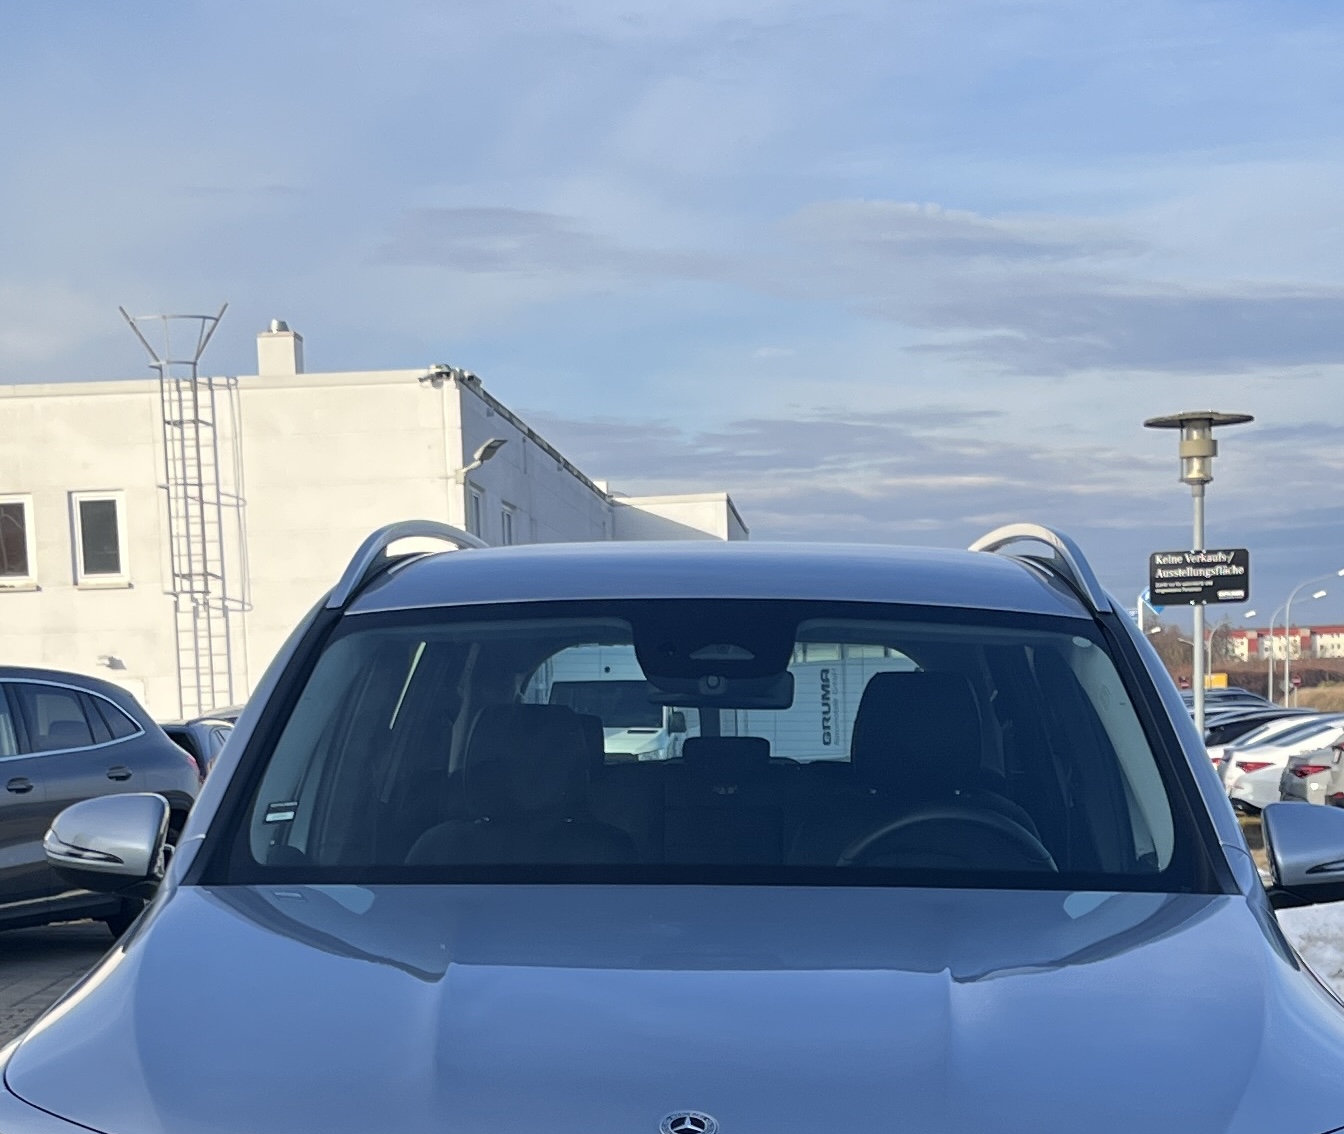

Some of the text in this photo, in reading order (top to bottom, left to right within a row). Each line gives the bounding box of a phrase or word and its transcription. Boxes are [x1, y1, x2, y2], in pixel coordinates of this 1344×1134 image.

[1155, 554, 1183, 565] Keine
[1155, 565, 1245, 579] Ausstellungsfläche
[820, 668, 832, 746] GRUMA
